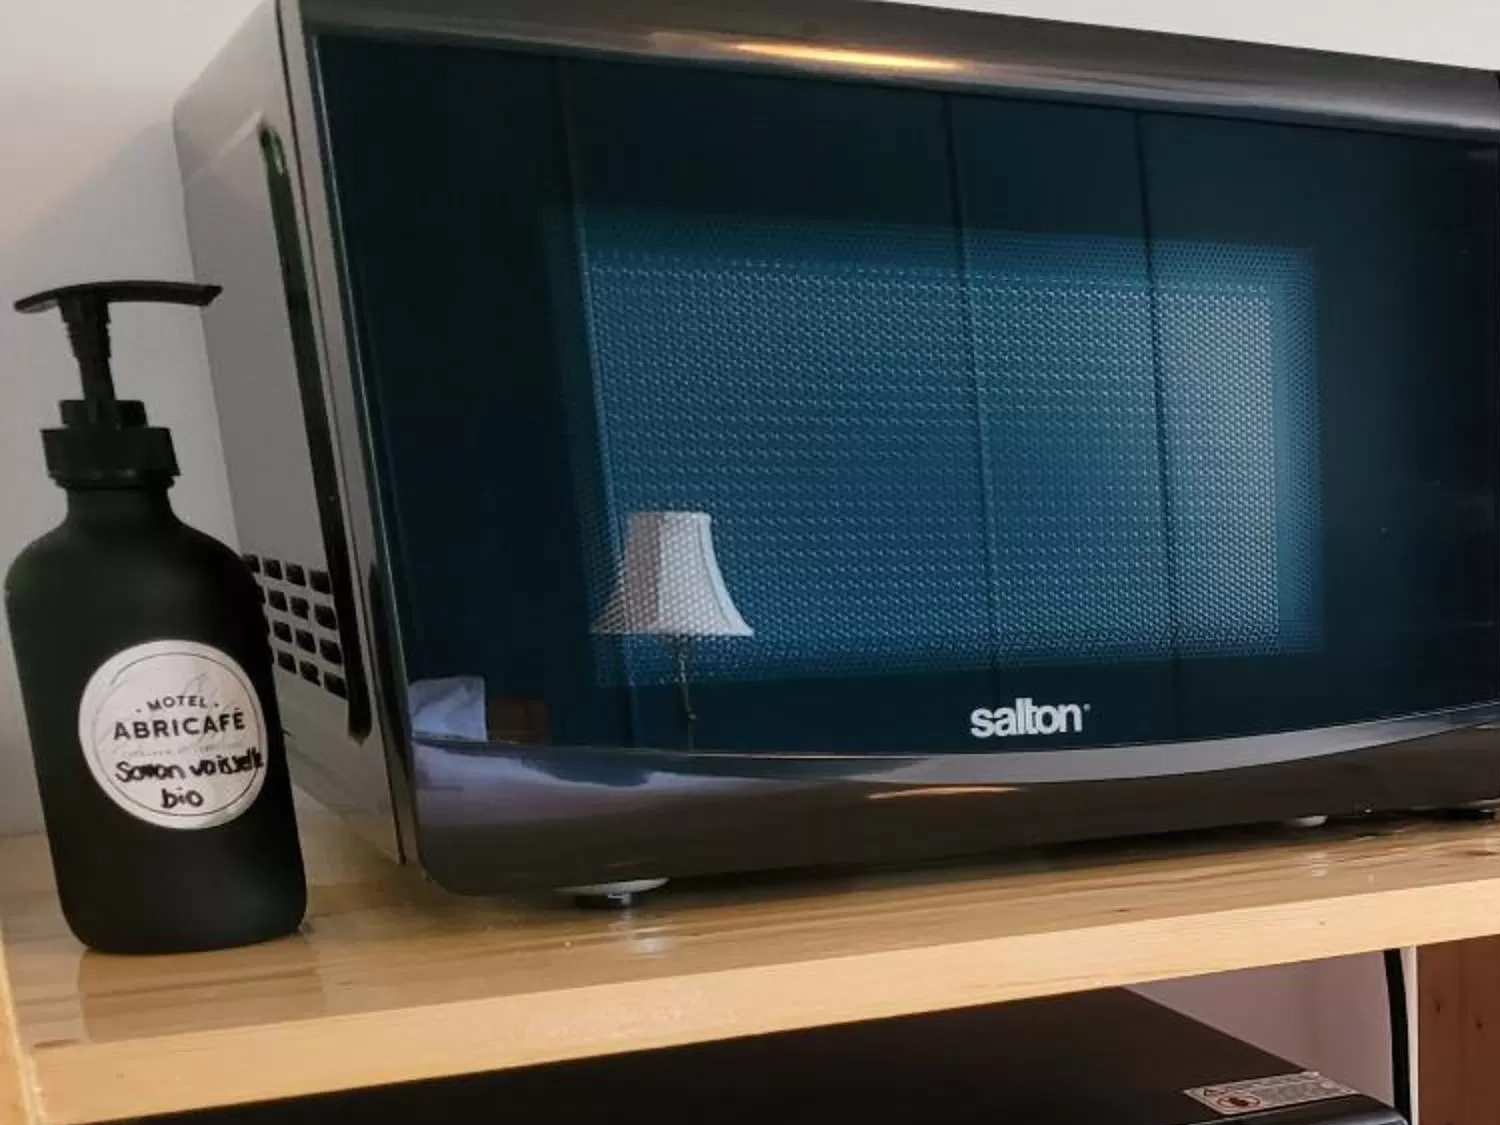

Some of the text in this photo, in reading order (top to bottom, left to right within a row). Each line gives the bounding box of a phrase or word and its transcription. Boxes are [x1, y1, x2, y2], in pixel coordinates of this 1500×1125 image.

[147, 695, 208, 711] MOTEL
[970, 698, 1082, 738] salton
[160, 786, 205, 809] bio
